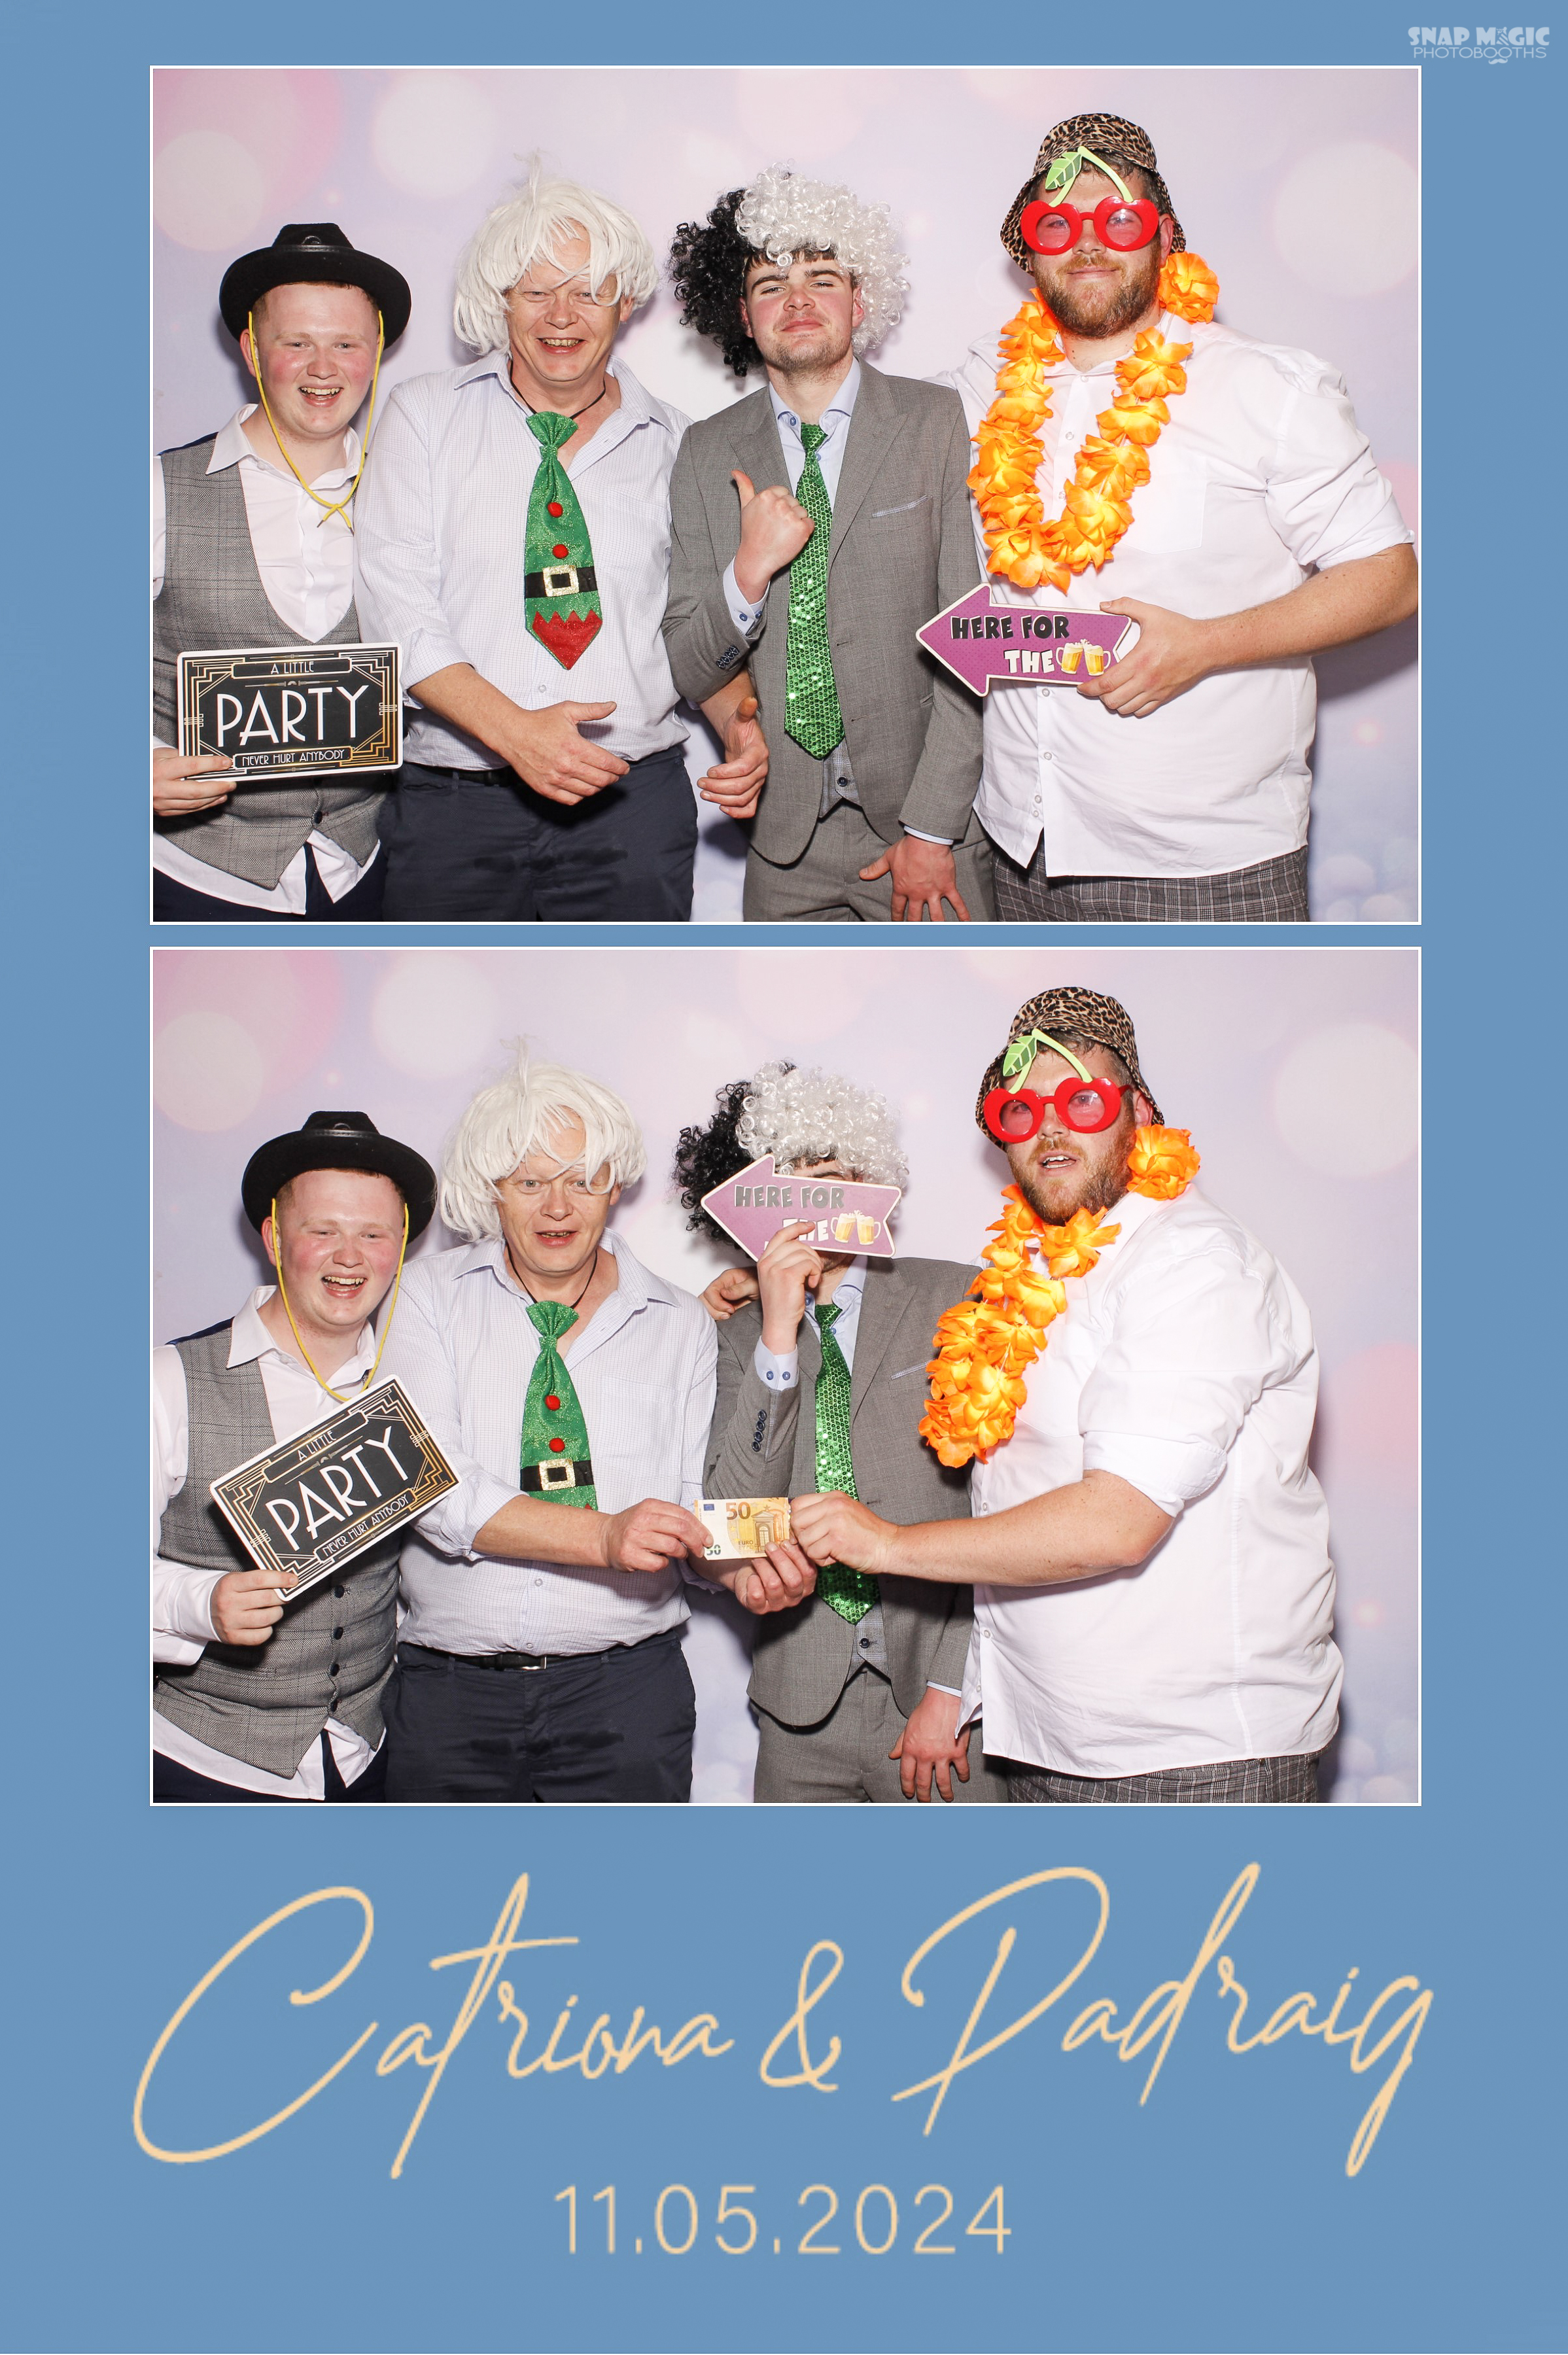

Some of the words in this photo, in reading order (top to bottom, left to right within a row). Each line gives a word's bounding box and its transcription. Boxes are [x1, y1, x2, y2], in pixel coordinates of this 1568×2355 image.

[950, 615, 1013, 640] HERE
[1020, 614, 1070, 639] FOR
[270, 663, 279, 674] A
[284, 661, 315, 674] LITTLE
[1003, 649, 1055, 674] THE
[217, 685, 369, 748] PARTY
[242, 756, 269, 766] NEVER
[273, 753, 296, 764] HURT
[300, 749, 345, 763] ANYBODY
[734, 1184, 793, 1208] HERE
[800, 1185, 845, 1209] FOR
[298, 1450, 307, 1462] A
[306, 1430, 337, 1454] LITTLE
[265, 1425, 408, 1552] PARTY
[725, 1501, 751, 1520] 50
[322, 1535, 348, 1557] NEVER
[347, 1520, 369, 1540] HURT
[371, 1494, 409, 1526] ANYBODY
